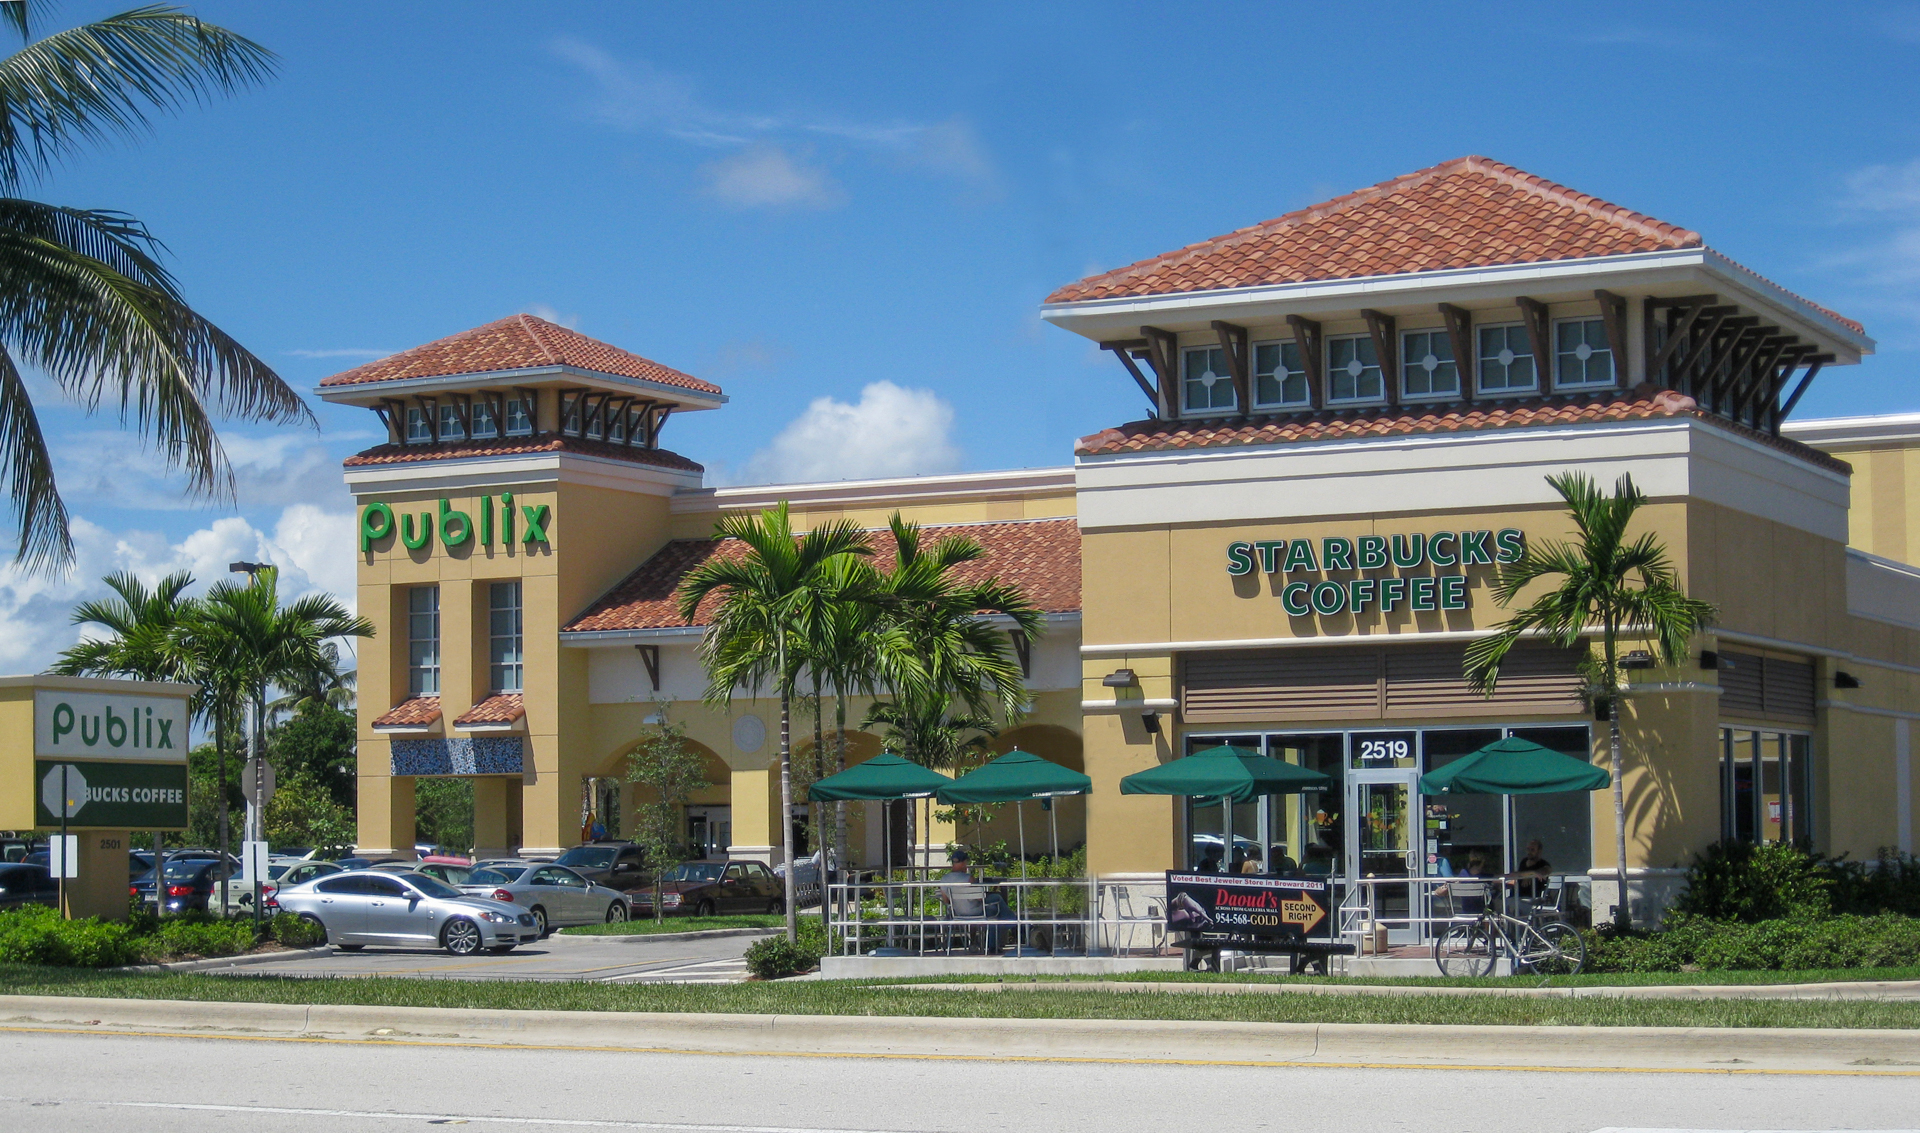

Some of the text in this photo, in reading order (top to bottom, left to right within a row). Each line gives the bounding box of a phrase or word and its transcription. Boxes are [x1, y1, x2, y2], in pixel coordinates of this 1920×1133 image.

[361, 491, 549, 553] Publix
[1226, 528, 1524, 576] STARBUCKS
[1281, 575, 1467, 617] COFFEE
[53, 702, 173, 749] Publix
[1361, 740, 1408, 759] 2519
[86, 786, 183, 804] BUCKS COFFEE
[100, 839, 121, 849] 2501
[1172, 874, 1193, 882] Voted
[1214, 877, 1243, 885] Jeweler
[1244, 878, 1264, 886] Store
[1274, 880, 1305, 888] Broward
[1215, 888, 1278, 908] Daoud's
[1284, 903, 1317, 912] SECOND
[1288, 912, 1313, 921] RIGHT
[1215, 912, 1279, 926] 954-568-GOLD
